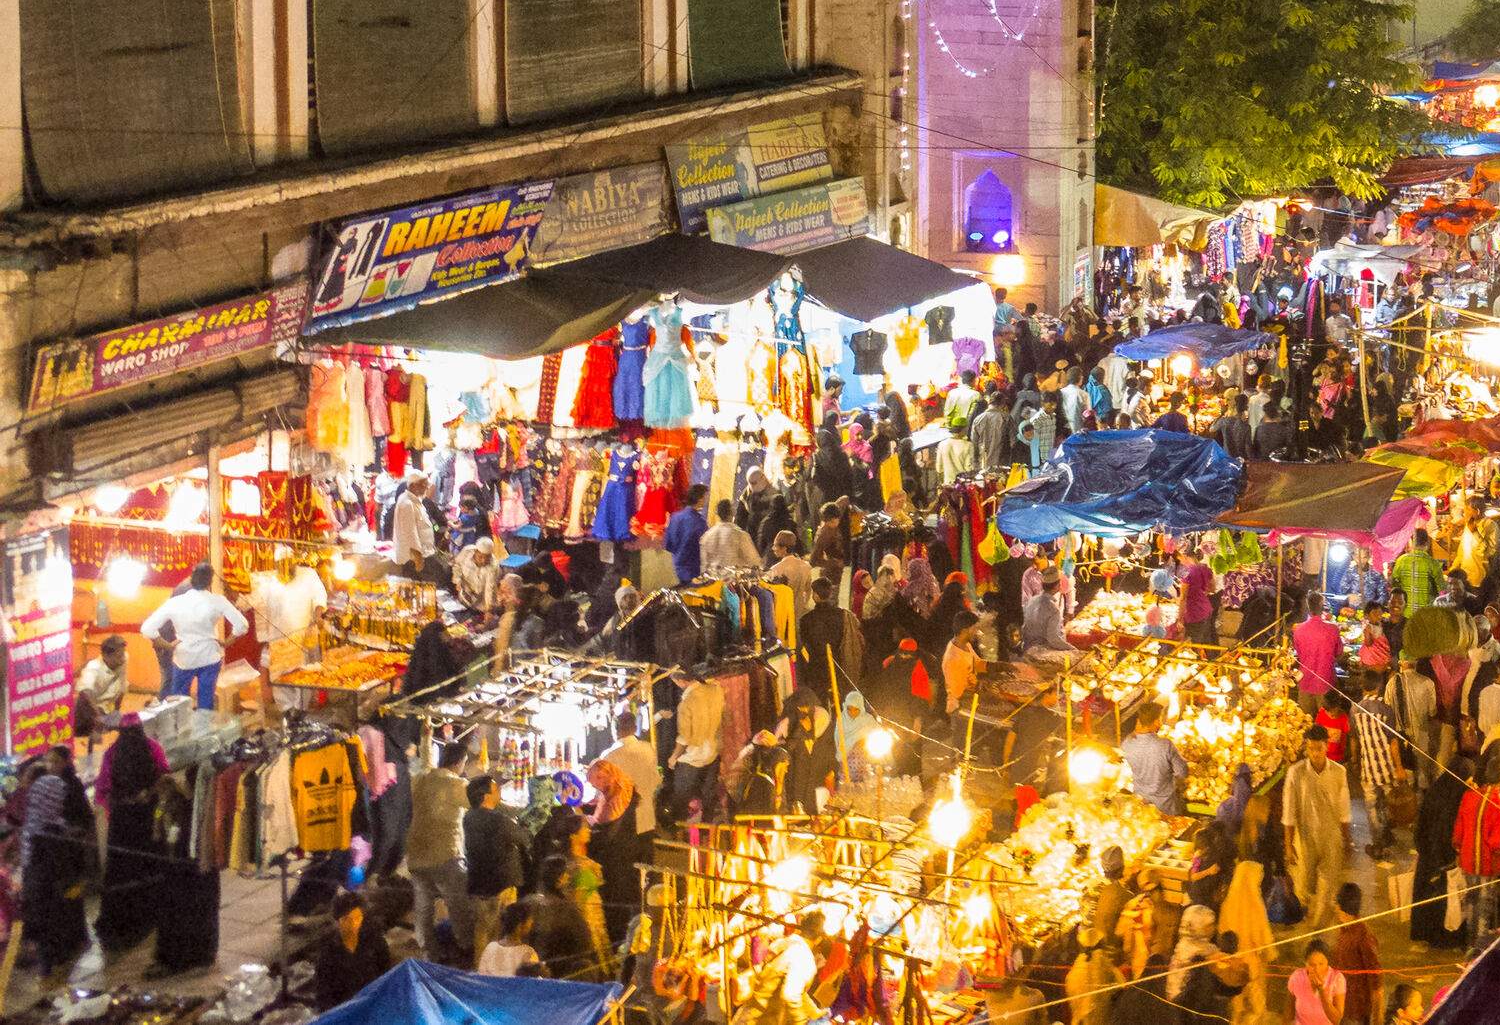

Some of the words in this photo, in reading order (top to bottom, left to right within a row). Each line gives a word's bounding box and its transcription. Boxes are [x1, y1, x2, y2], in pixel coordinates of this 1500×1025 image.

[677, 160, 735, 188] Collection
[707, 184, 722, 201] KIDS
[722, 181, 740, 197] WEAR
[775, 197, 830, 223] Collection
[382, 199, 511, 257] RAHEEM
[756, 226, 777, 242] MENS
[786, 218, 803, 235] KIDS
[803, 215, 825, 231] WEAR
[437, 235, 515, 268] Collection
[101, 299, 272, 361] CHARMINAR
[150, 342, 190, 364] SHOP
